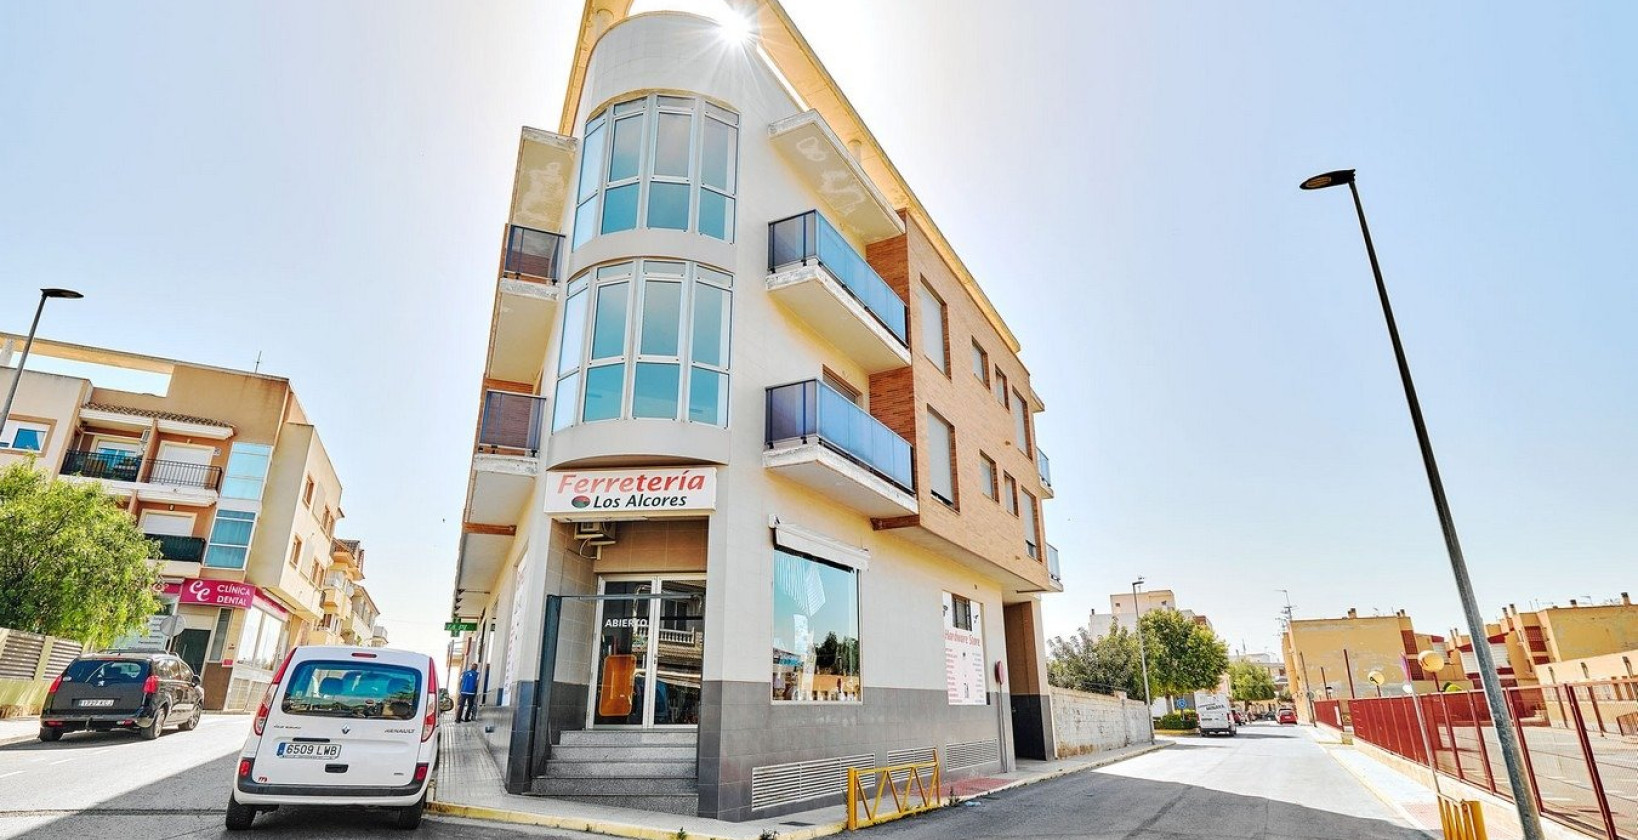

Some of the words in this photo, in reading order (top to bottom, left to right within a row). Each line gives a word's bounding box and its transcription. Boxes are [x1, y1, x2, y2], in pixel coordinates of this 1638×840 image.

[557, 470, 705, 494] Ferretería
[593, 495, 620, 509] Los
[625, 493, 688, 508] Alcores
[216, 583, 251, 597] CLÍNICA
[216, 595, 248, 606] DENTAL
[286, 744, 314, 755] 6509
[316, 745, 338, 756] LWB
